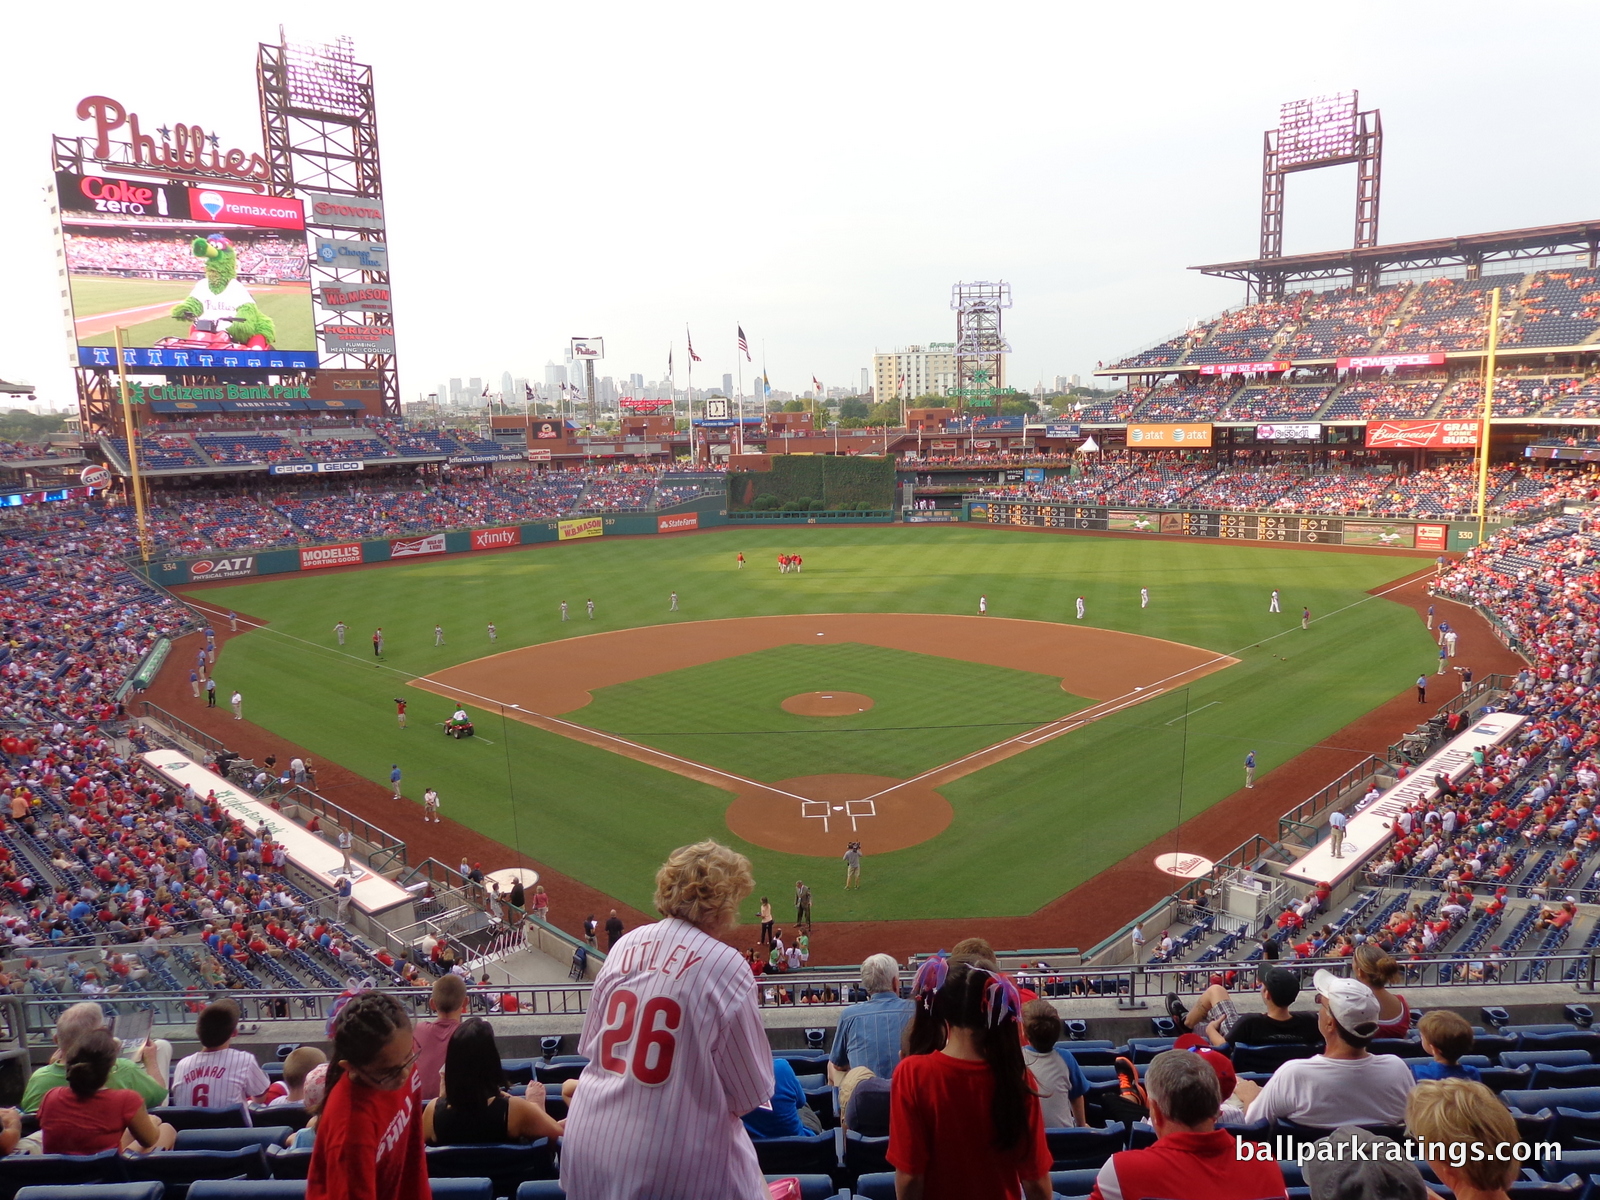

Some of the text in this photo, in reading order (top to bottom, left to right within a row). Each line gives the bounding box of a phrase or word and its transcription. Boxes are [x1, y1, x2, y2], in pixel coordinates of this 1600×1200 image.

[76, 95, 271, 180] Phillies
[80, 176, 153, 204] Coke
[95, 198, 145, 215] zero
[225, 203, 298, 219] remax.com
[331, 204, 382, 219] TOYOTA
[337, 246, 370, 257] Choose
[203, 299, 237, 311] Phillies
[324, 326, 394, 336] HORIZON
[575, 347, 597, 355] Phillies
[148, 383, 311, 400] Citizens Bank Park
[947, 385, 1016, 396] Citizens Bank
[970, 398, 992, 407] Park
[1443, 423, 1478, 431] GRAB
[1145, 429, 1207, 440] at&t at&t
[1369, 428, 1438, 440] Budweiser
[1442, 436, 1477, 444] BUDS
[499, 453, 523, 461] Hospitals
[275, 461, 359, 474] GEICO GEICO
[85, 472, 108, 483] Gulf
[1458, 531, 1473, 539] 330
[302, 547, 360, 560] MODELL'S
[162, 563, 177, 571] 334
[212, 557, 253, 572] ATI
[303, 559, 336, 567] SPORTING
[224, 569, 251, 577] THERAPY
[1370, 748, 1474, 818] PHILADELPHIA PHILLIES
[621, 940, 702, 982] UTLEY
[600, 987, 682, 1087] 26
[184, 1065, 226, 1085] HOWARD
[192, 1083, 209, 1107] 6
